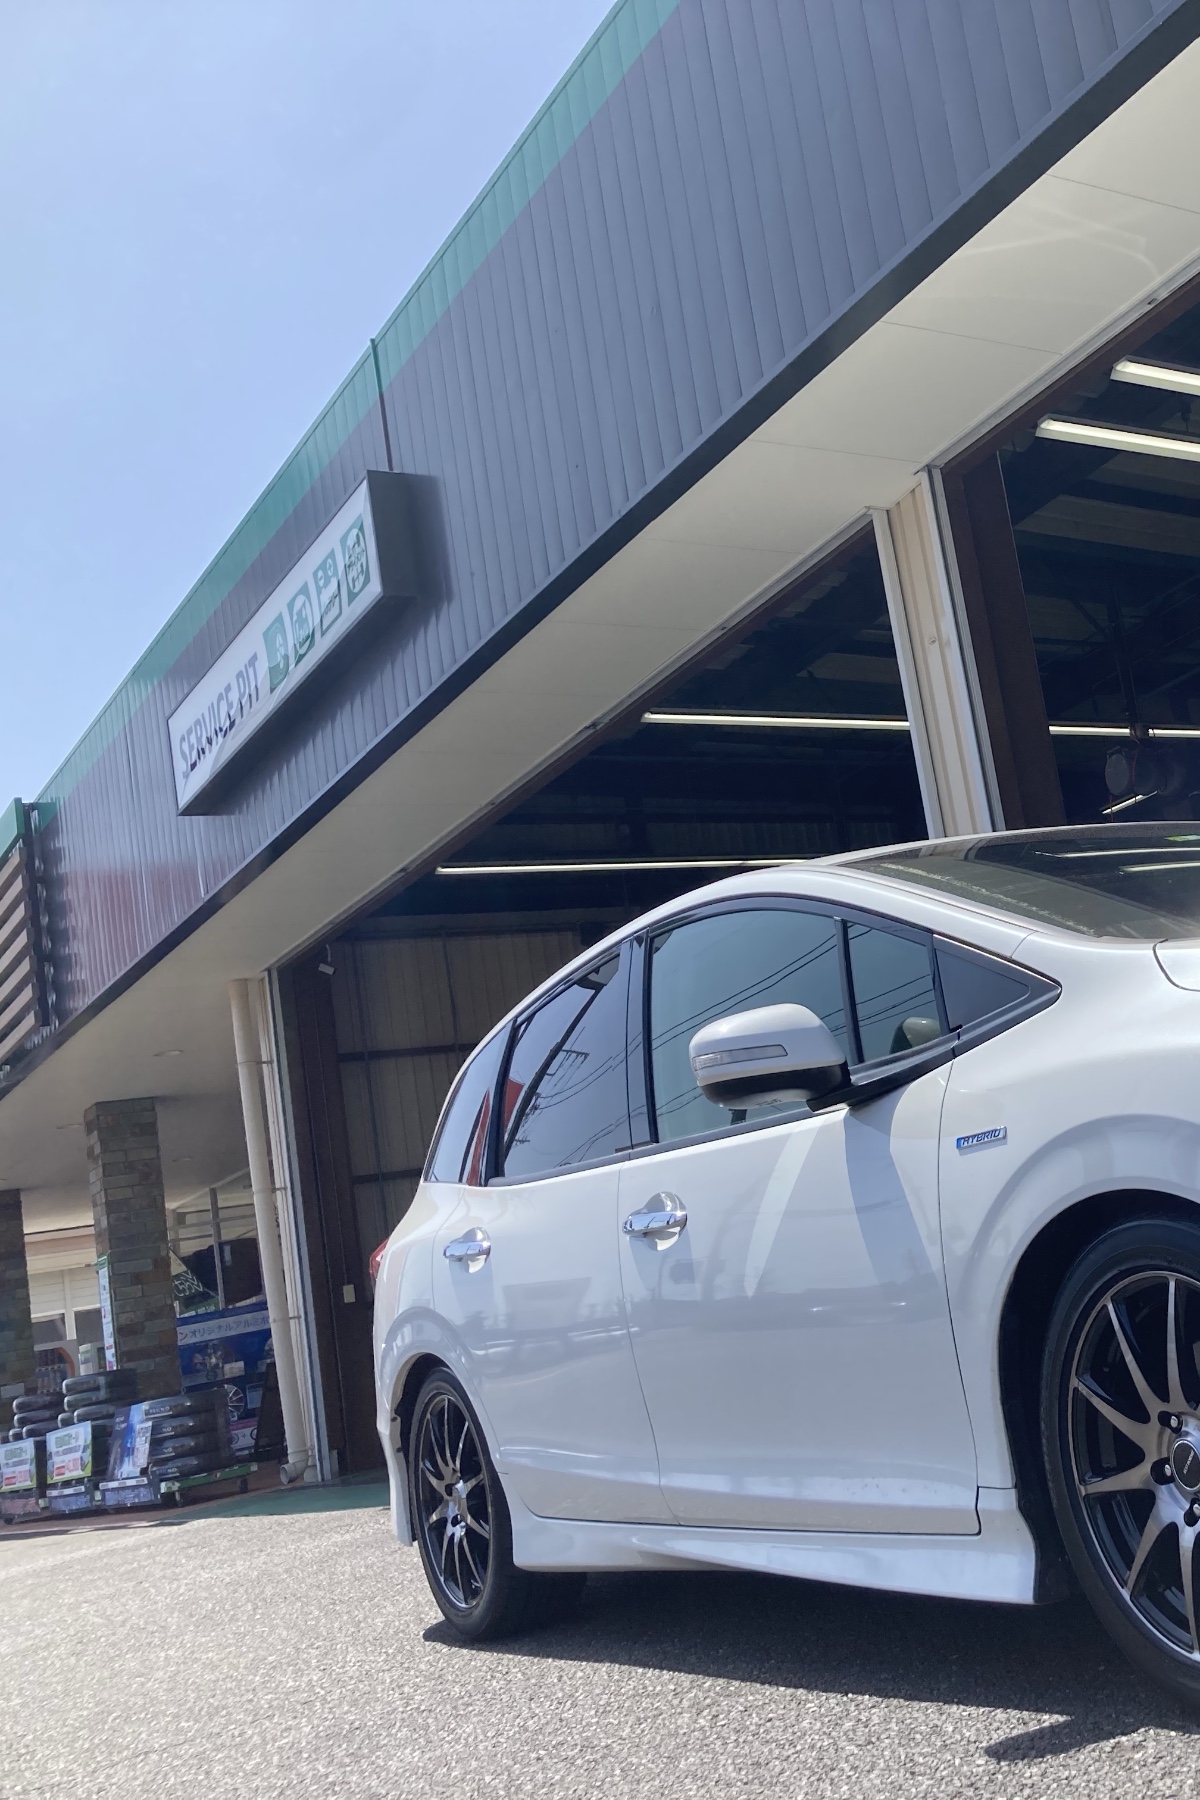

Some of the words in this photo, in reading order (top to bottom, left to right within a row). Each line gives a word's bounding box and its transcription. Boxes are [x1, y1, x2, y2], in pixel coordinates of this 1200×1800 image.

[179, 684, 236, 779] SERVICE
[236, 652, 259, 719] PIT
[962, 1129, 1001, 1145] HYBRID
